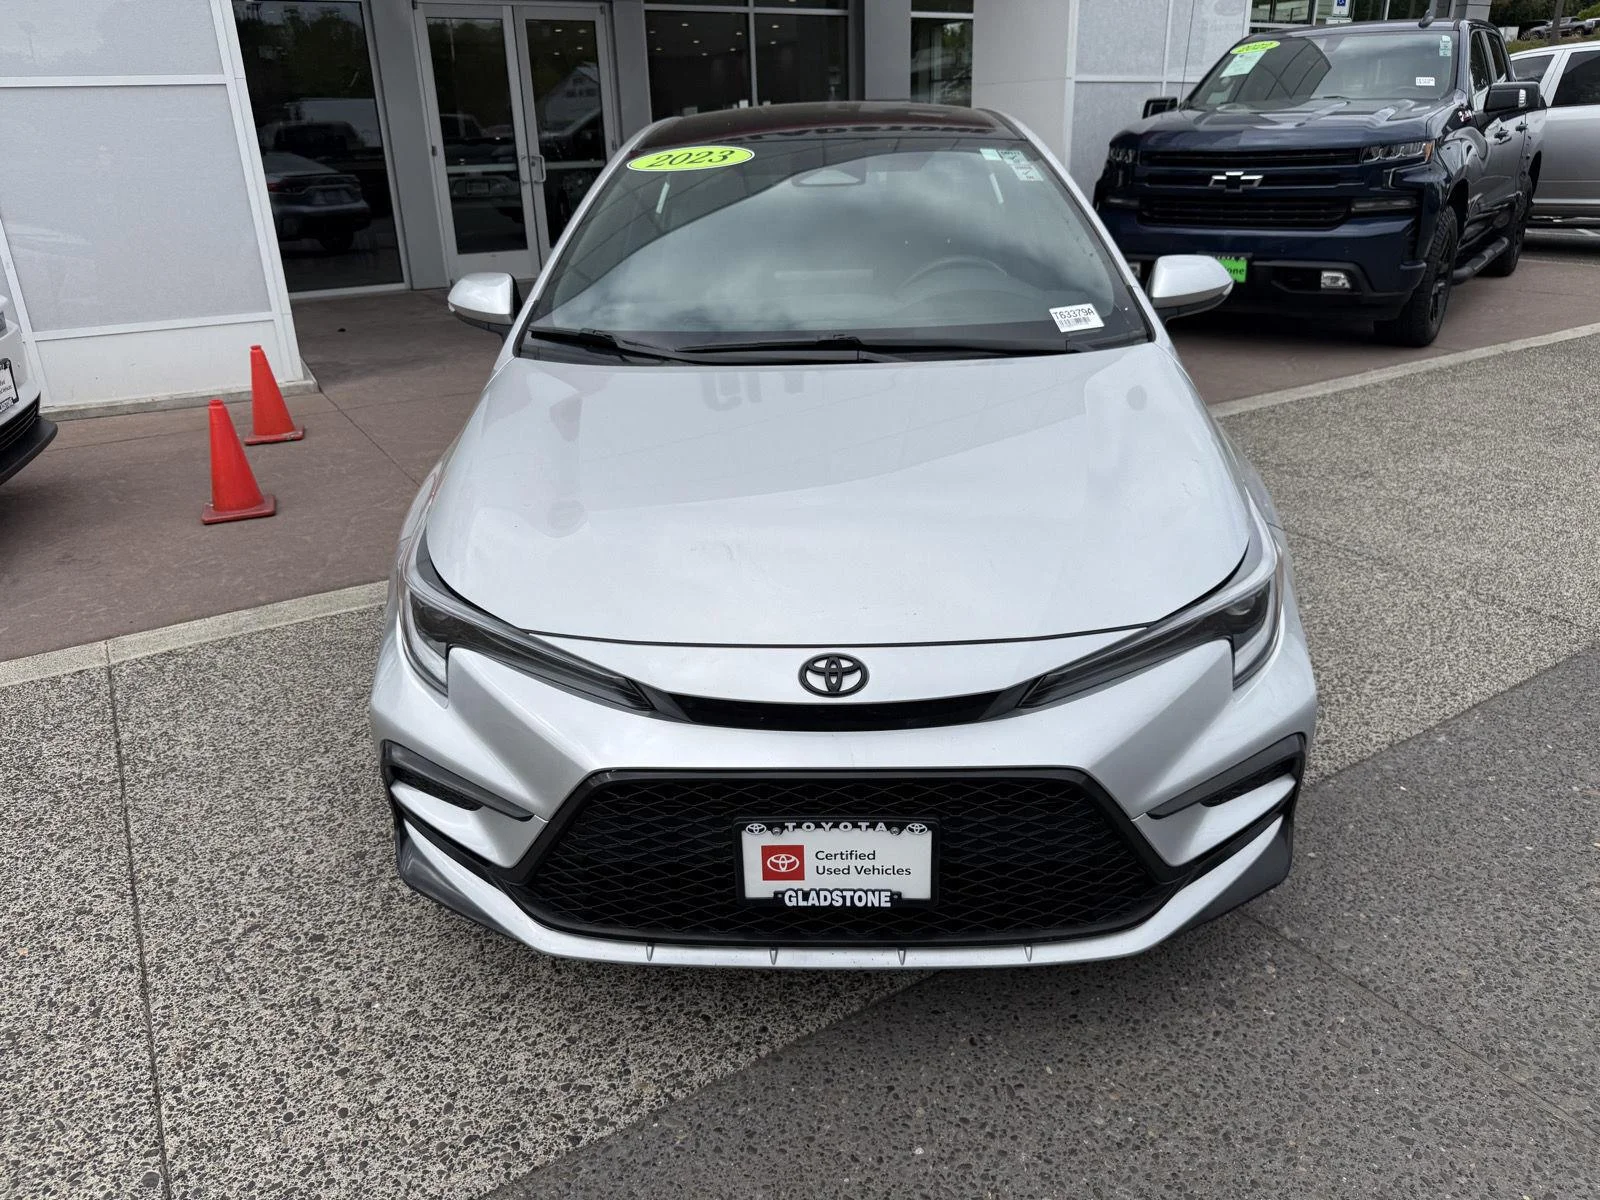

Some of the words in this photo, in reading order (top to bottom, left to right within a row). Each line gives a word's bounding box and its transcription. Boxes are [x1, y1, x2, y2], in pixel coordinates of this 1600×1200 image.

[646, 150, 735, 168] 2023
[1052, 307, 1095, 320] T63379A
[785, 822, 888, 832] TOYOTA
[815, 850, 876, 861] Certified
[815, 865, 851, 876] Used
[854, 865, 912, 876] Vehicles
[784, 890, 891, 907] GLADSTONE
